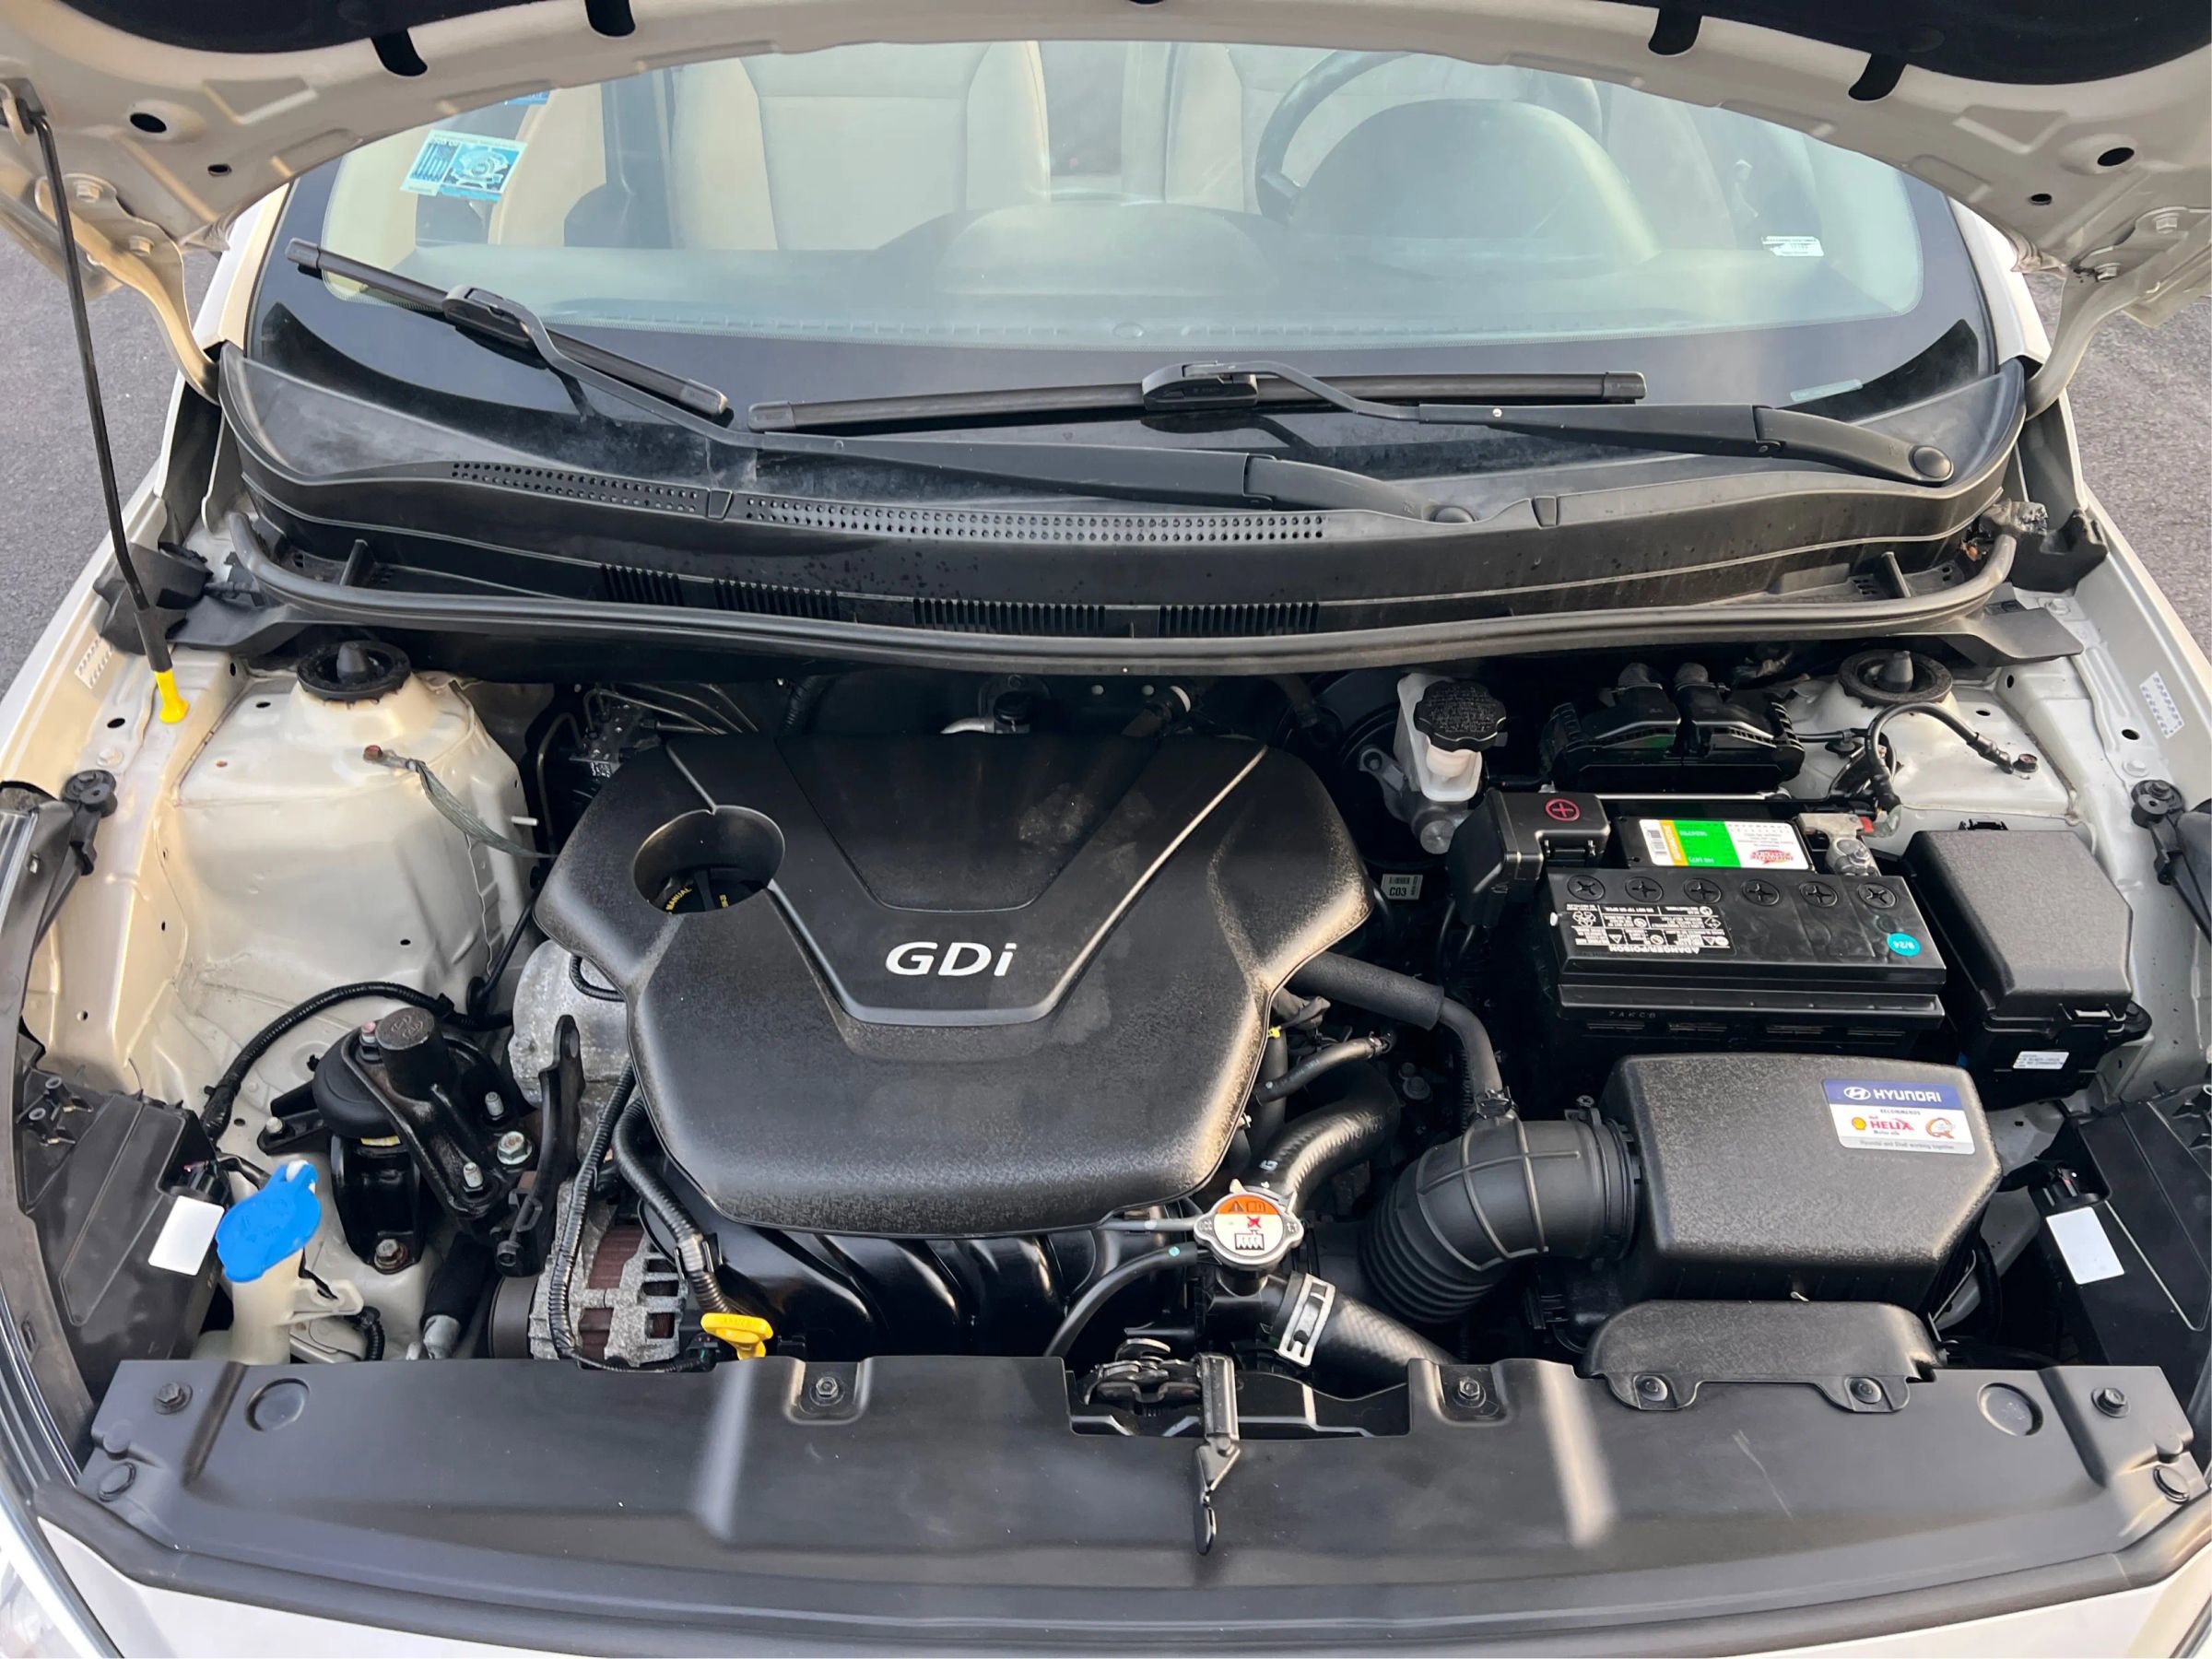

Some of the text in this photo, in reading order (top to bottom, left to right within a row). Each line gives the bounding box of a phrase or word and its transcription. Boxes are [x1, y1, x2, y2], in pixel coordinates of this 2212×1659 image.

[1390, 886, 1407, 897] C03
[665, 887, 693, 911] MANUAL
[886, 942, 1017, 976] GDi
[1873, 1089, 1942, 1102] HYUNDAI
[1869, 1118, 1914, 1131] HELIX
